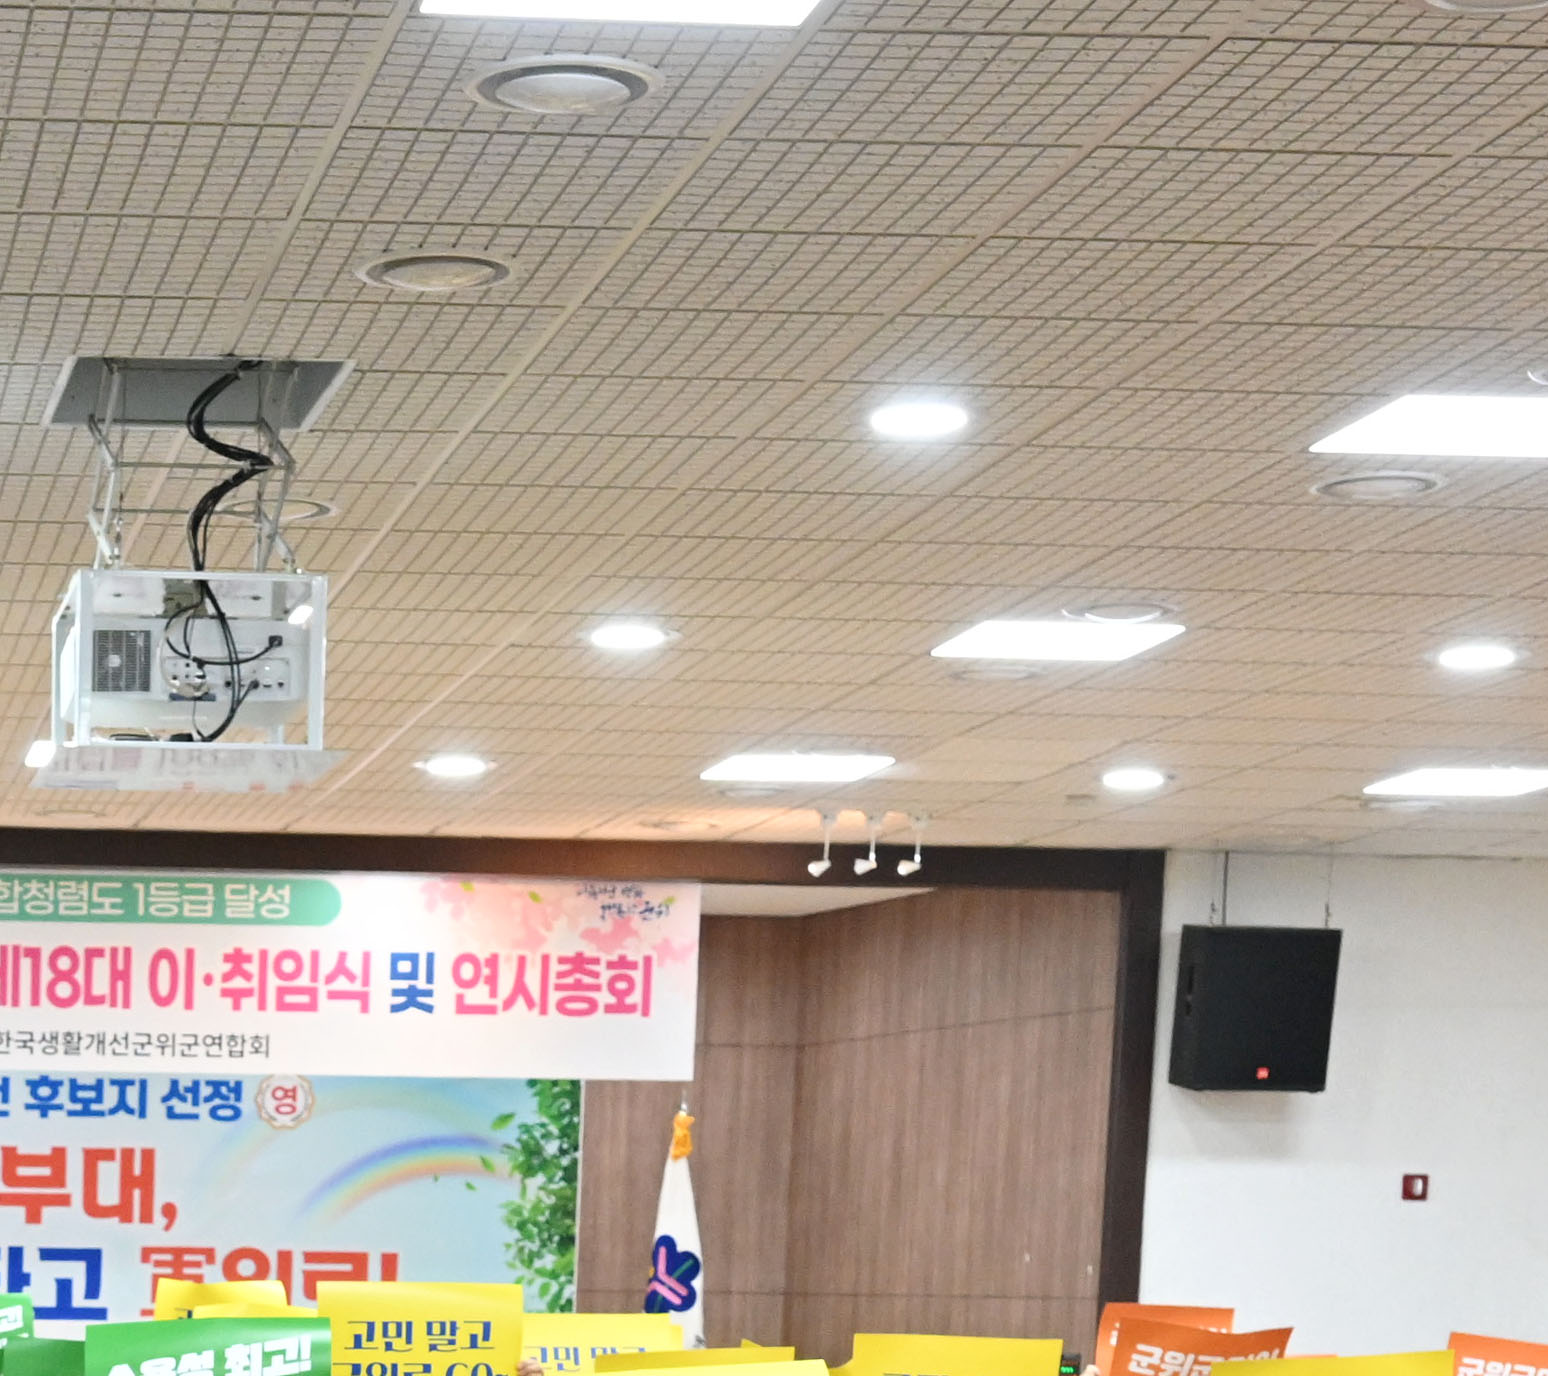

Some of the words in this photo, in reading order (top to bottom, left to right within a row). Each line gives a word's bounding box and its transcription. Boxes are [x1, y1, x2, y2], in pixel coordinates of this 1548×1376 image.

[131, 881, 215, 918] 1등급
[224, 882, 292, 919] 달성
[389, 951, 436, 1014] 및
[451, 951, 654, 1018] 연시총회
[24, 1075, 148, 1119] 후보지
[160, 1078, 244, 1123] 선정
[270, 1085, 300, 1116] 영
[343, 1319, 413, 1353] 고민
[425, 1319, 496, 1353] 말고
